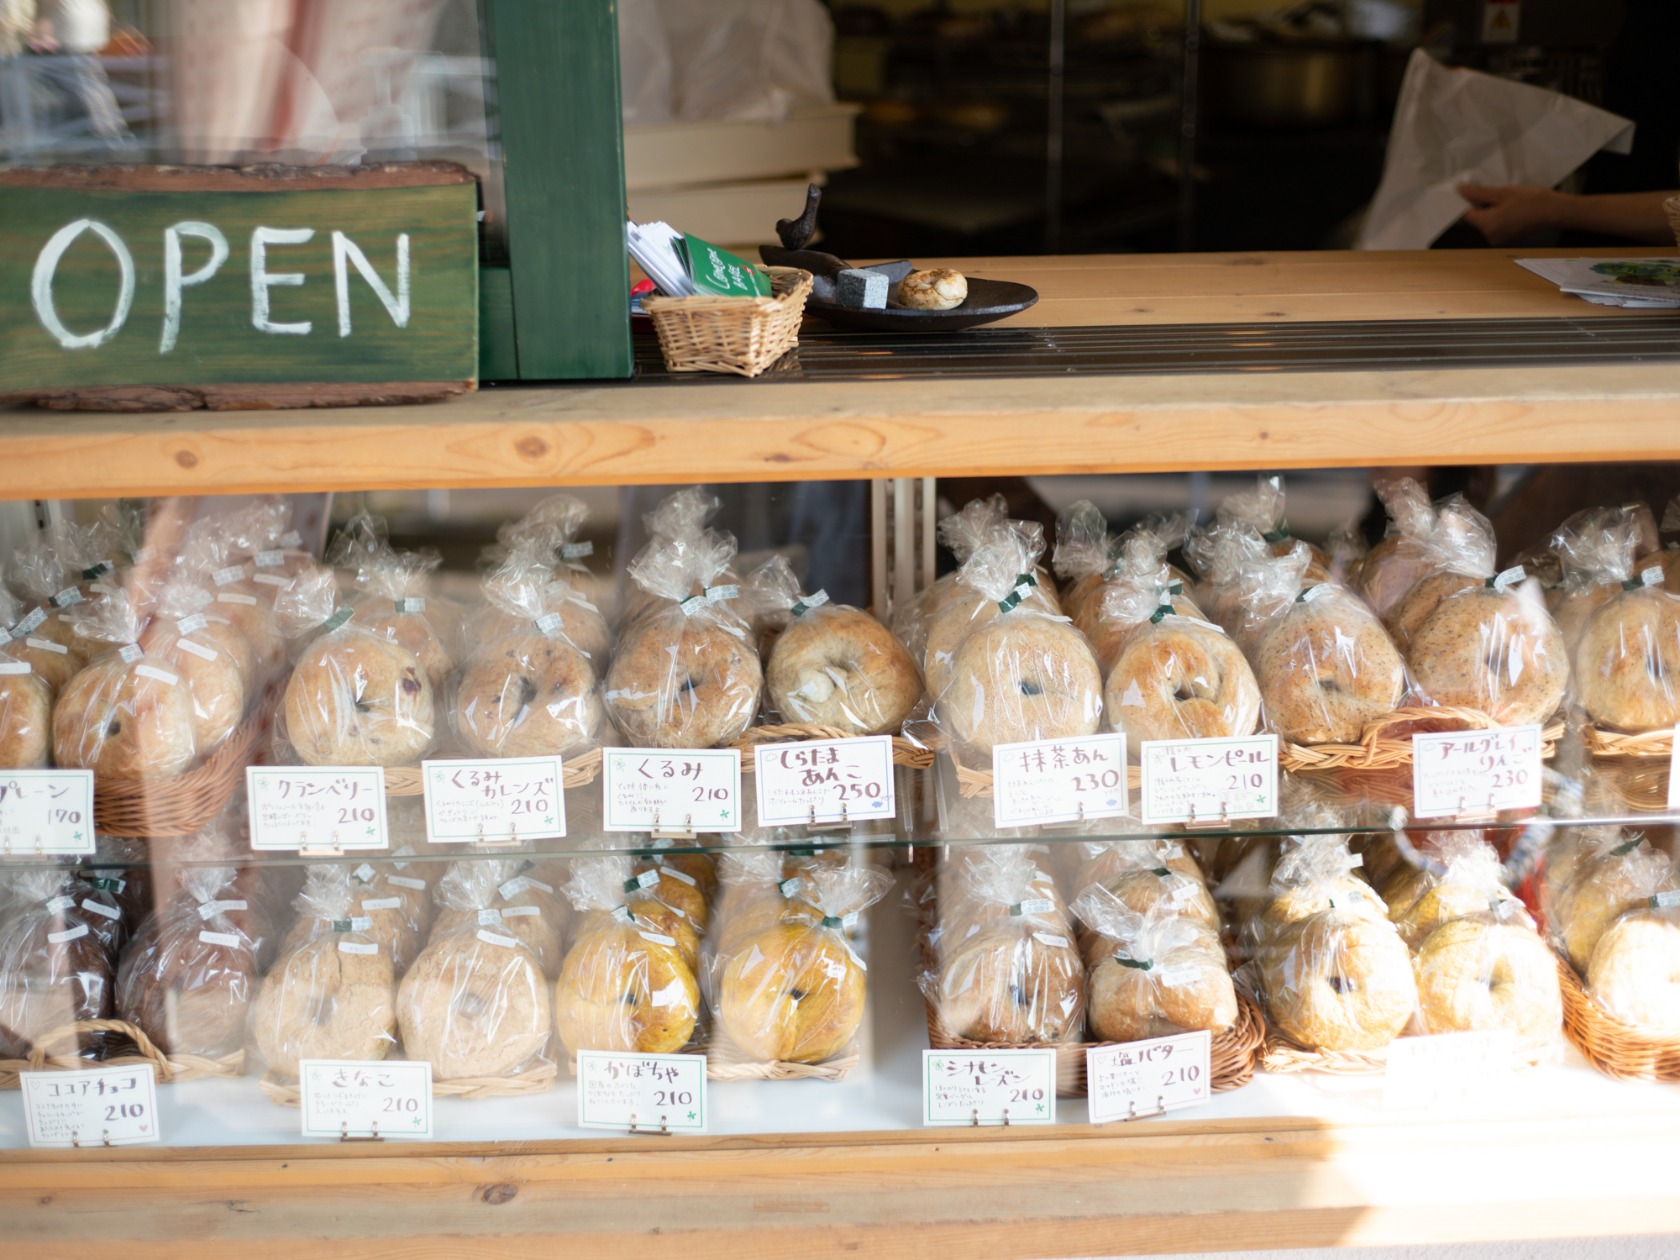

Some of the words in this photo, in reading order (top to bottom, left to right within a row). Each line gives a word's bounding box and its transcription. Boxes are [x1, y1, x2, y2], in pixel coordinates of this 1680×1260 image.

[32, 218, 410, 354] OPEN
[779, 746, 840, 770] しらたま
[1018, 744, 1110, 773] 抹茶あん
[451, 768, 502, 789] くるみ
[637, 758, 704, 781] くるみ
[798, 764, 863, 788] あんこ
[1490, 769, 1529, 789] 230
[278, 778, 374, 800] クランベリー
[481, 777, 555, 800] カレンズ
[1071, 769, 1120, 792] 230
[1225, 773, 1264, 790] 210
[692, 786, 729, 802] 210
[832, 781, 882, 801] 250
[337, 807, 376, 824] 210
[511, 799, 549, 814] 210
[47, 809, 82, 825] 170
[1110, 1044, 1194, 1067] 塩バター
[331, 1068, 397, 1088] きなこ
[603, 1060, 680, 1084] かぼちゃ
[1161, 1065, 1201, 1087] 210
[46, 1077, 137, 1097] ココアチョコ
[1009, 1088, 1045, 1103] 210
[383, 1097, 419, 1112] 210
[653, 1091, 693, 1106] 210
[104, 1103, 145, 1121] 210
